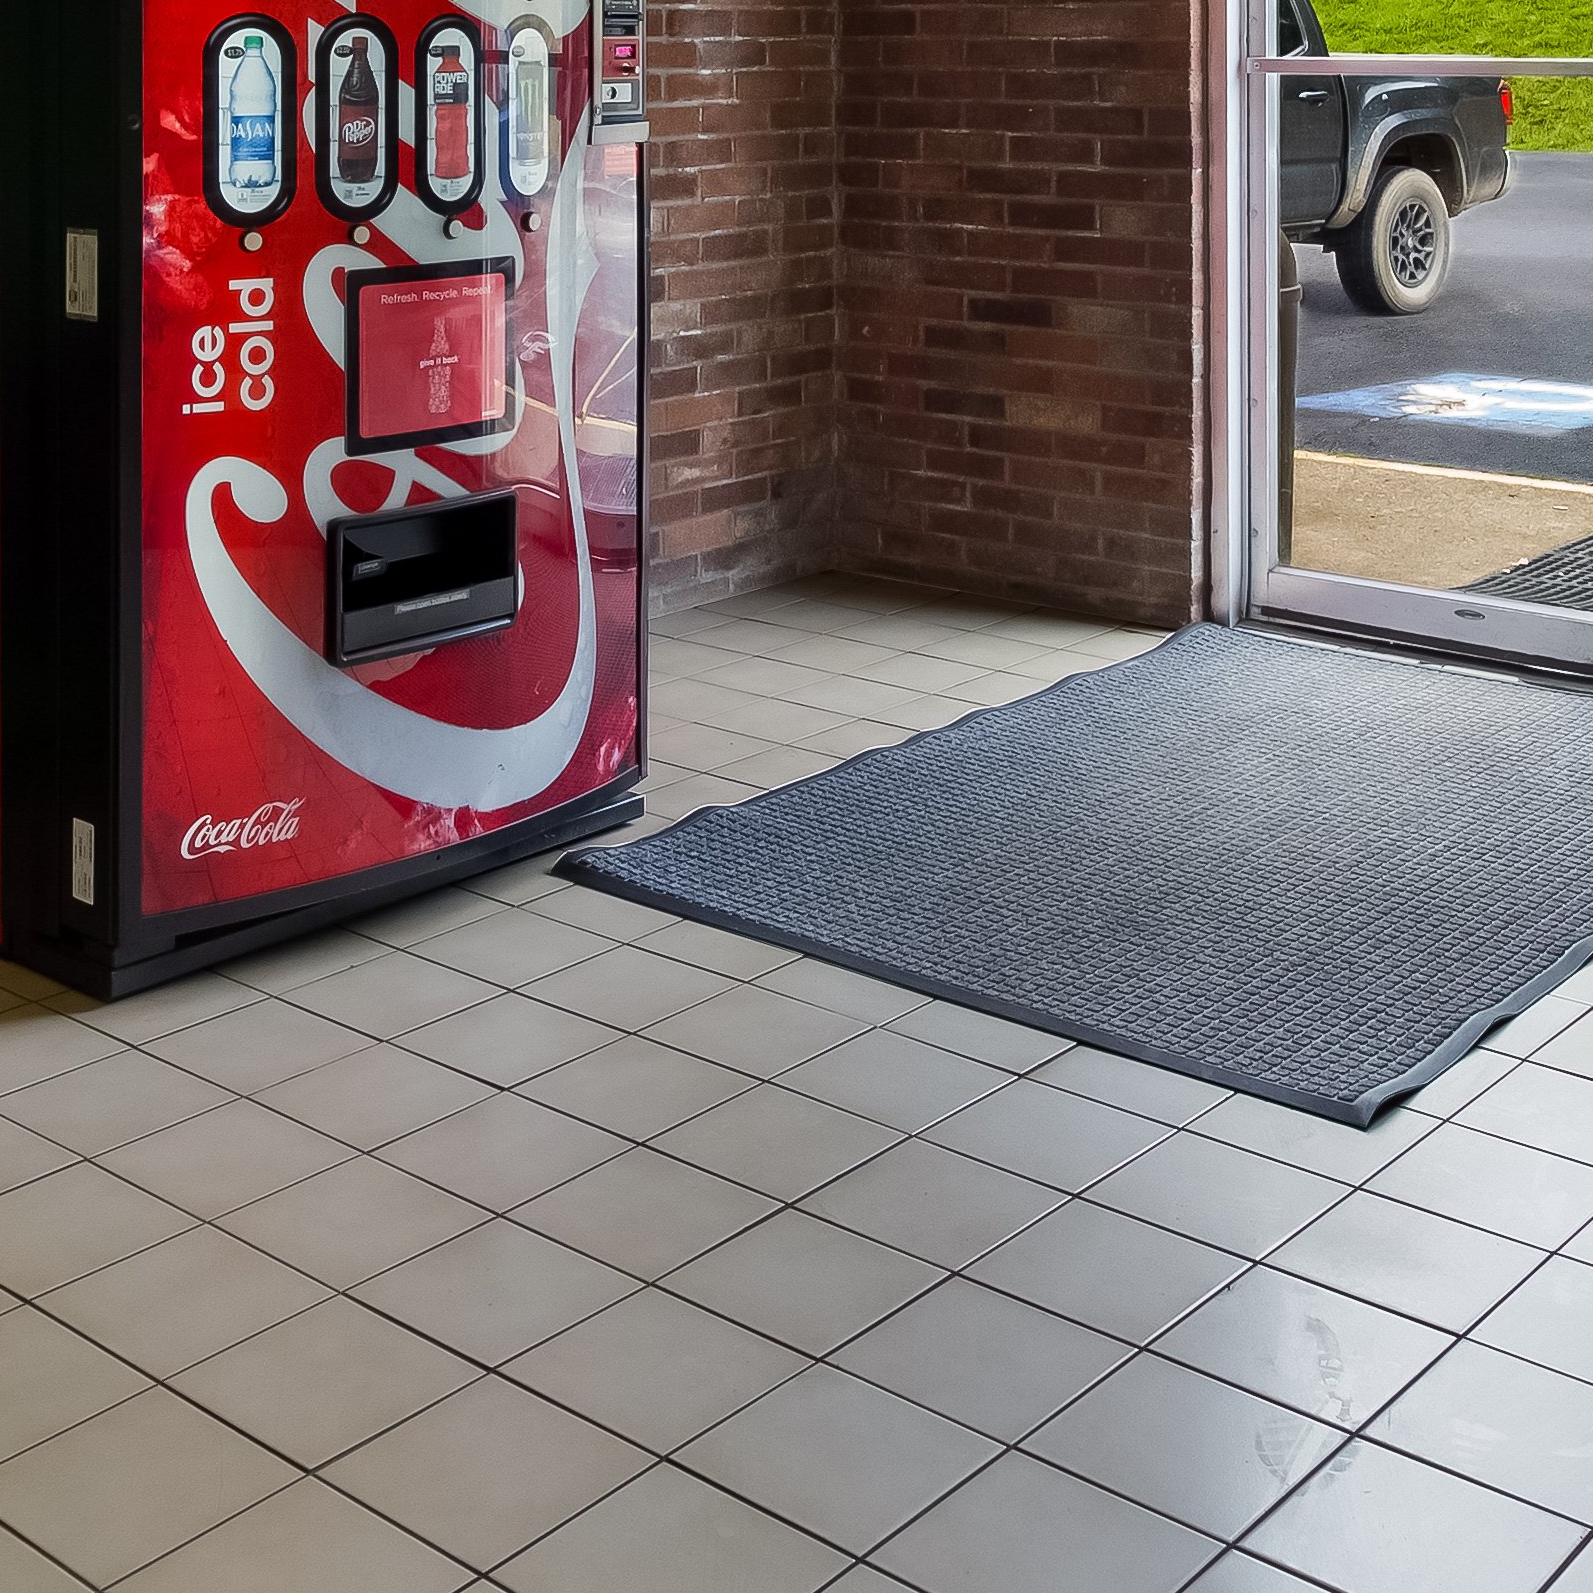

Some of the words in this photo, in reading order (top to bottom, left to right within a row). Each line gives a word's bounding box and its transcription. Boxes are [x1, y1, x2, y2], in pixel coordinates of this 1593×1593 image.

[435, 72, 468, 84] POWER
[435, 83, 454, 94] ADE
[342, 122, 374, 143] Pepper
[353, 120, 367, 131] Dr
[380, 292, 420, 305] Refresh.
[422, 288, 460, 301] Recycle.
[228, 277, 275, 411] cold
[182, 325, 225, 415] ice
[180, 797, 306, 860] Coca-Cola
